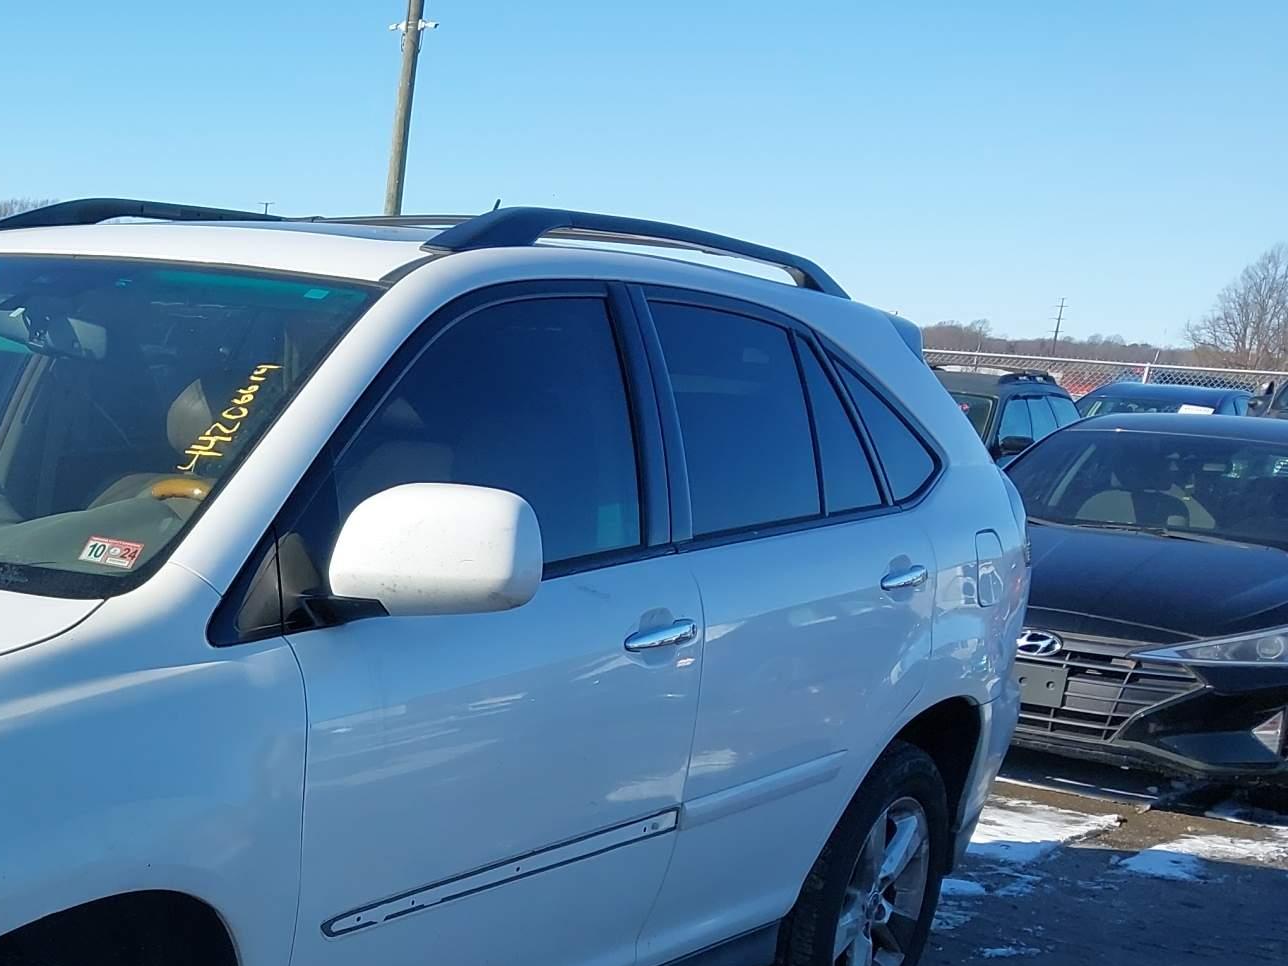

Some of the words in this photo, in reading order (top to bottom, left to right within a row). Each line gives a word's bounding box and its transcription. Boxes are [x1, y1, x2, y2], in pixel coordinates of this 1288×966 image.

[177, 364, 283, 473] 44206614
[87, 542, 107, 559] 10
[119, 547, 139, 561] 24
